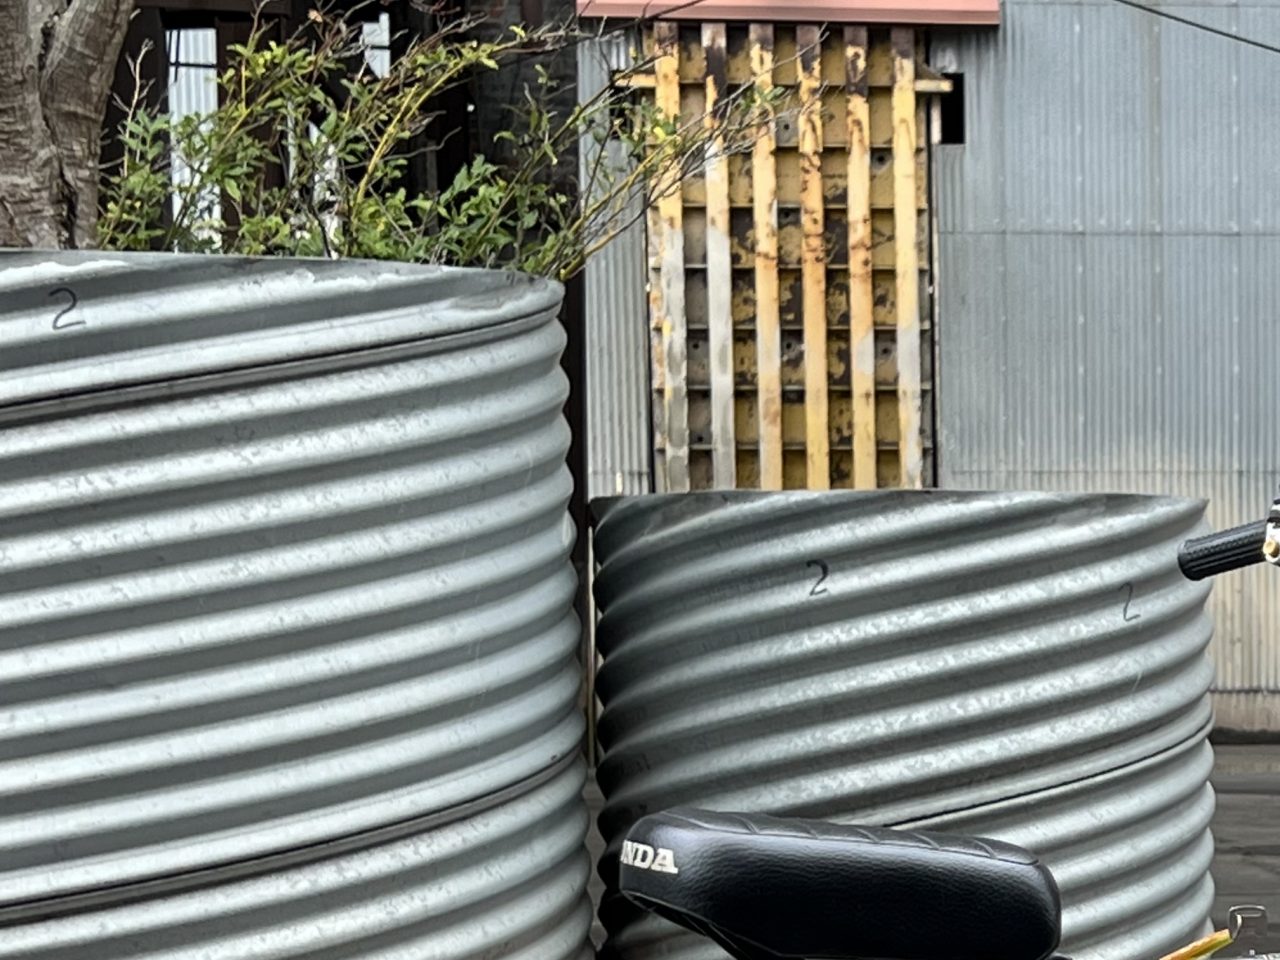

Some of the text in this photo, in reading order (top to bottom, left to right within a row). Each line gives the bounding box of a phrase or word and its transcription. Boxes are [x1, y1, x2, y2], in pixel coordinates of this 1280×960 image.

[48, 287, 87, 330] 2
[806, 559, 829, 596] 2
[1118, 581, 1141, 621] 2
